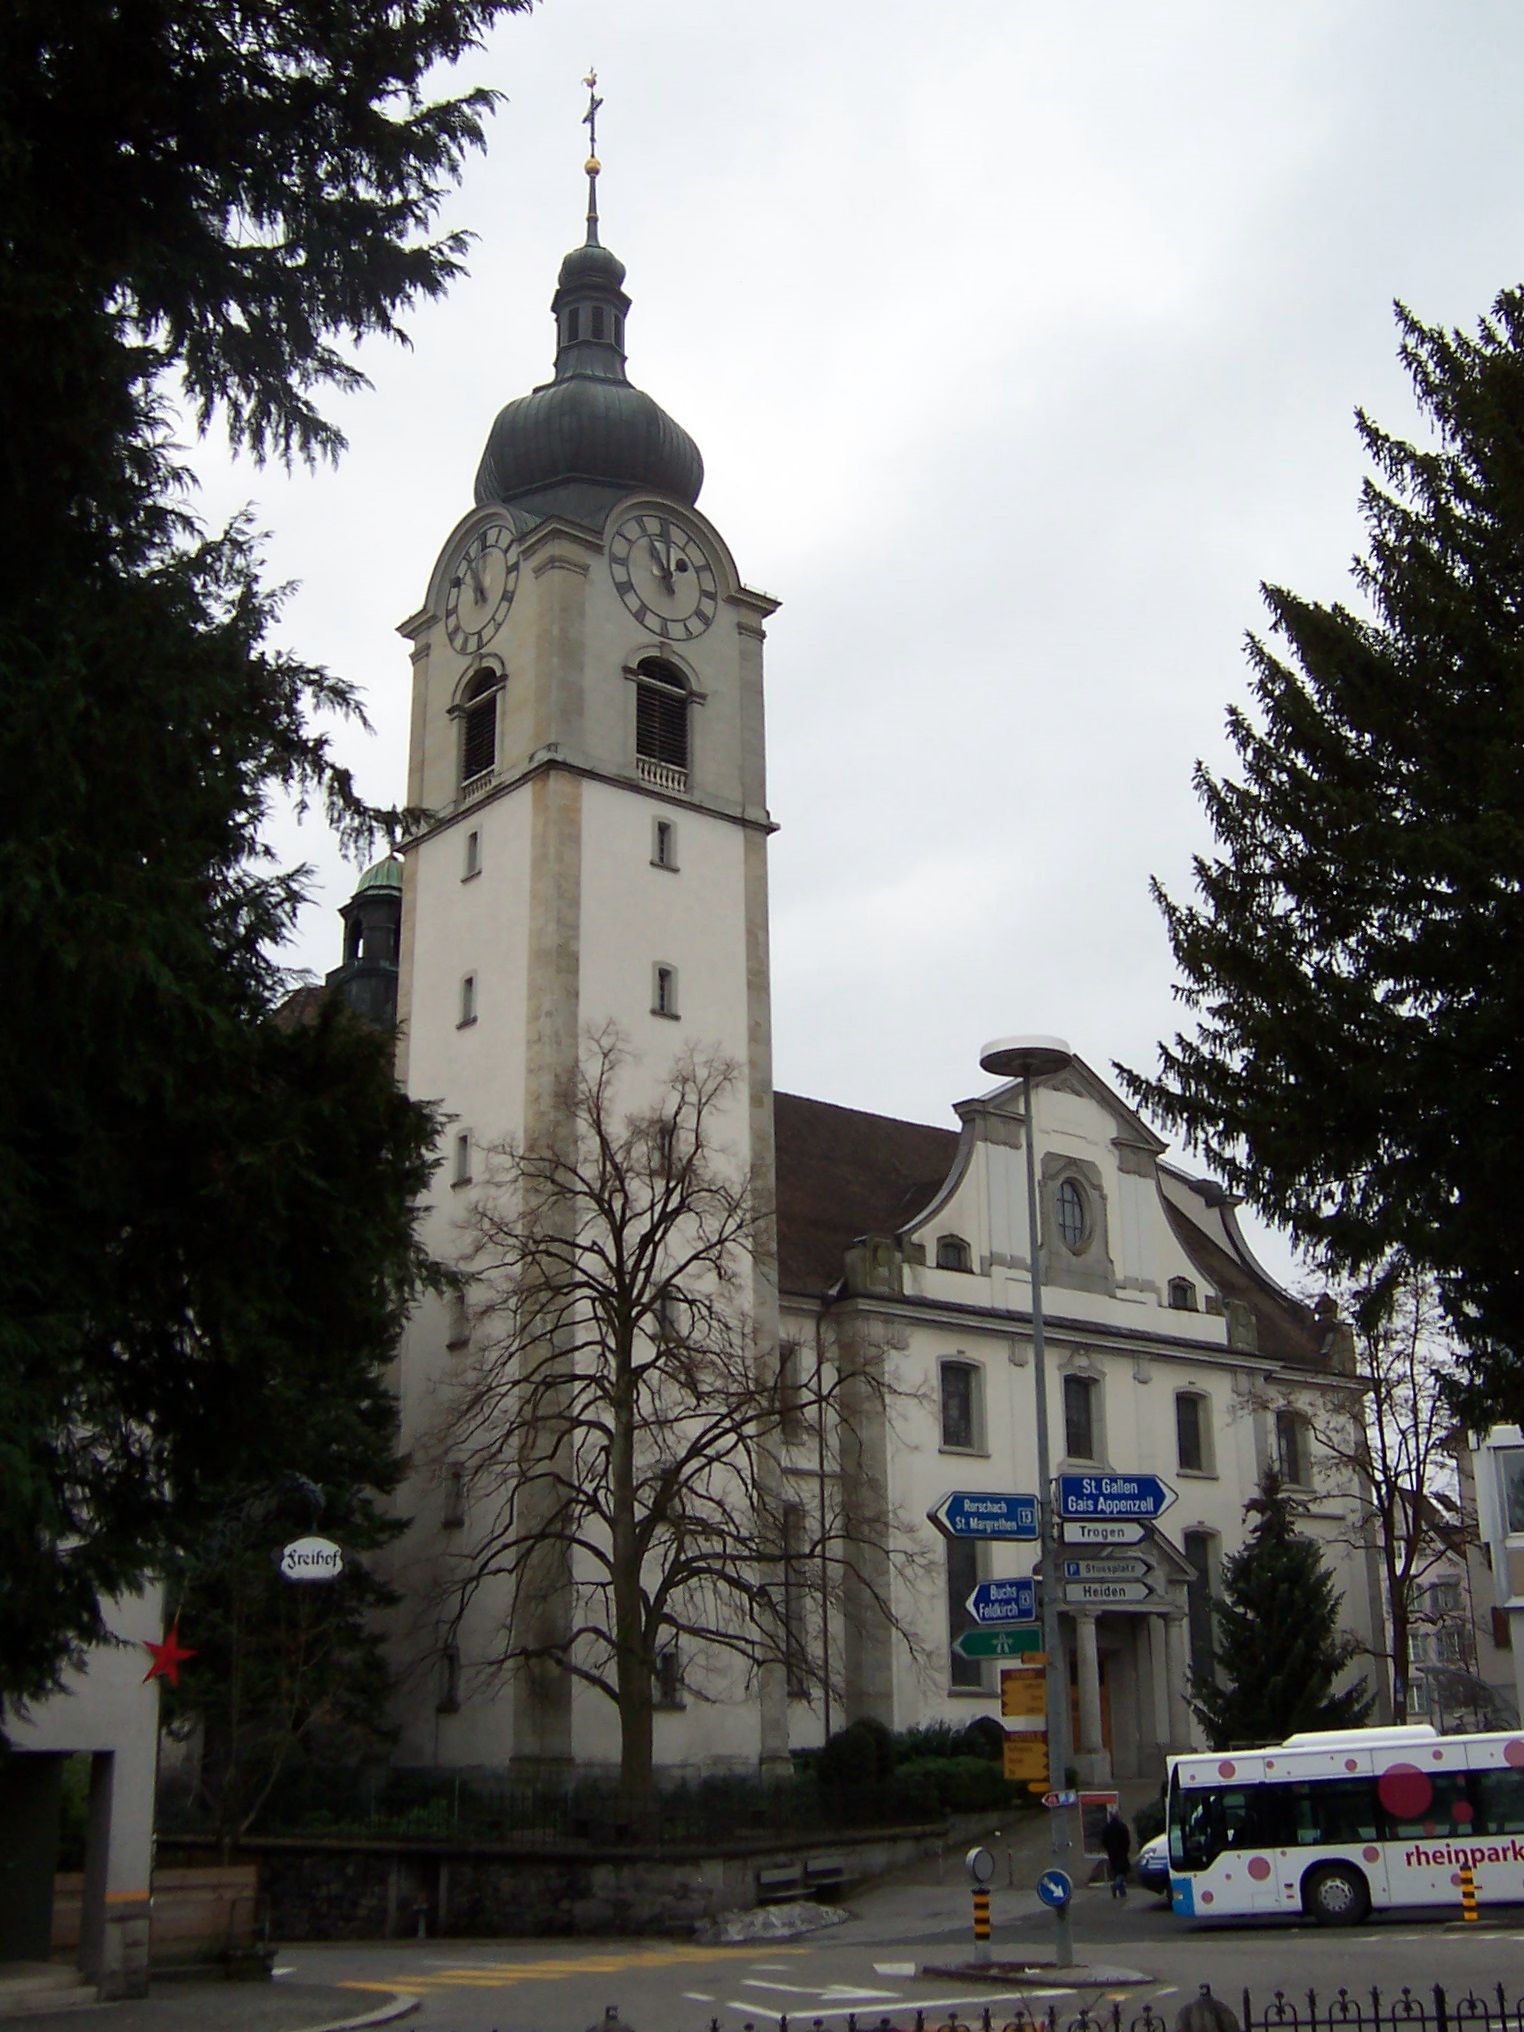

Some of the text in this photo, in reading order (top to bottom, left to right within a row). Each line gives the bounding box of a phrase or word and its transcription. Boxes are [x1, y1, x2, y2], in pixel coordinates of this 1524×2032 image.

[1082, 1479, 1138, 1494] St. Gallen
[963, 1499, 1007, 1513] Rorschach
[1068, 1496, 1154, 1514] Gais Appenzell
[970, 1517, 1017, 1533] Margrethen
[1021, 1511, 1032, 1523] 13
[1079, 1525, 1125, 1540] Trogen
[287, 1549, 340, 1570] Freihof
[990, 1584, 1017, 1600] Buchs
[1083, 1585, 1126, 1598] Heiden
[979, 1601, 1018, 1618] Feldkirch
[1405, 1839, 1524, 1870] rheinpark
